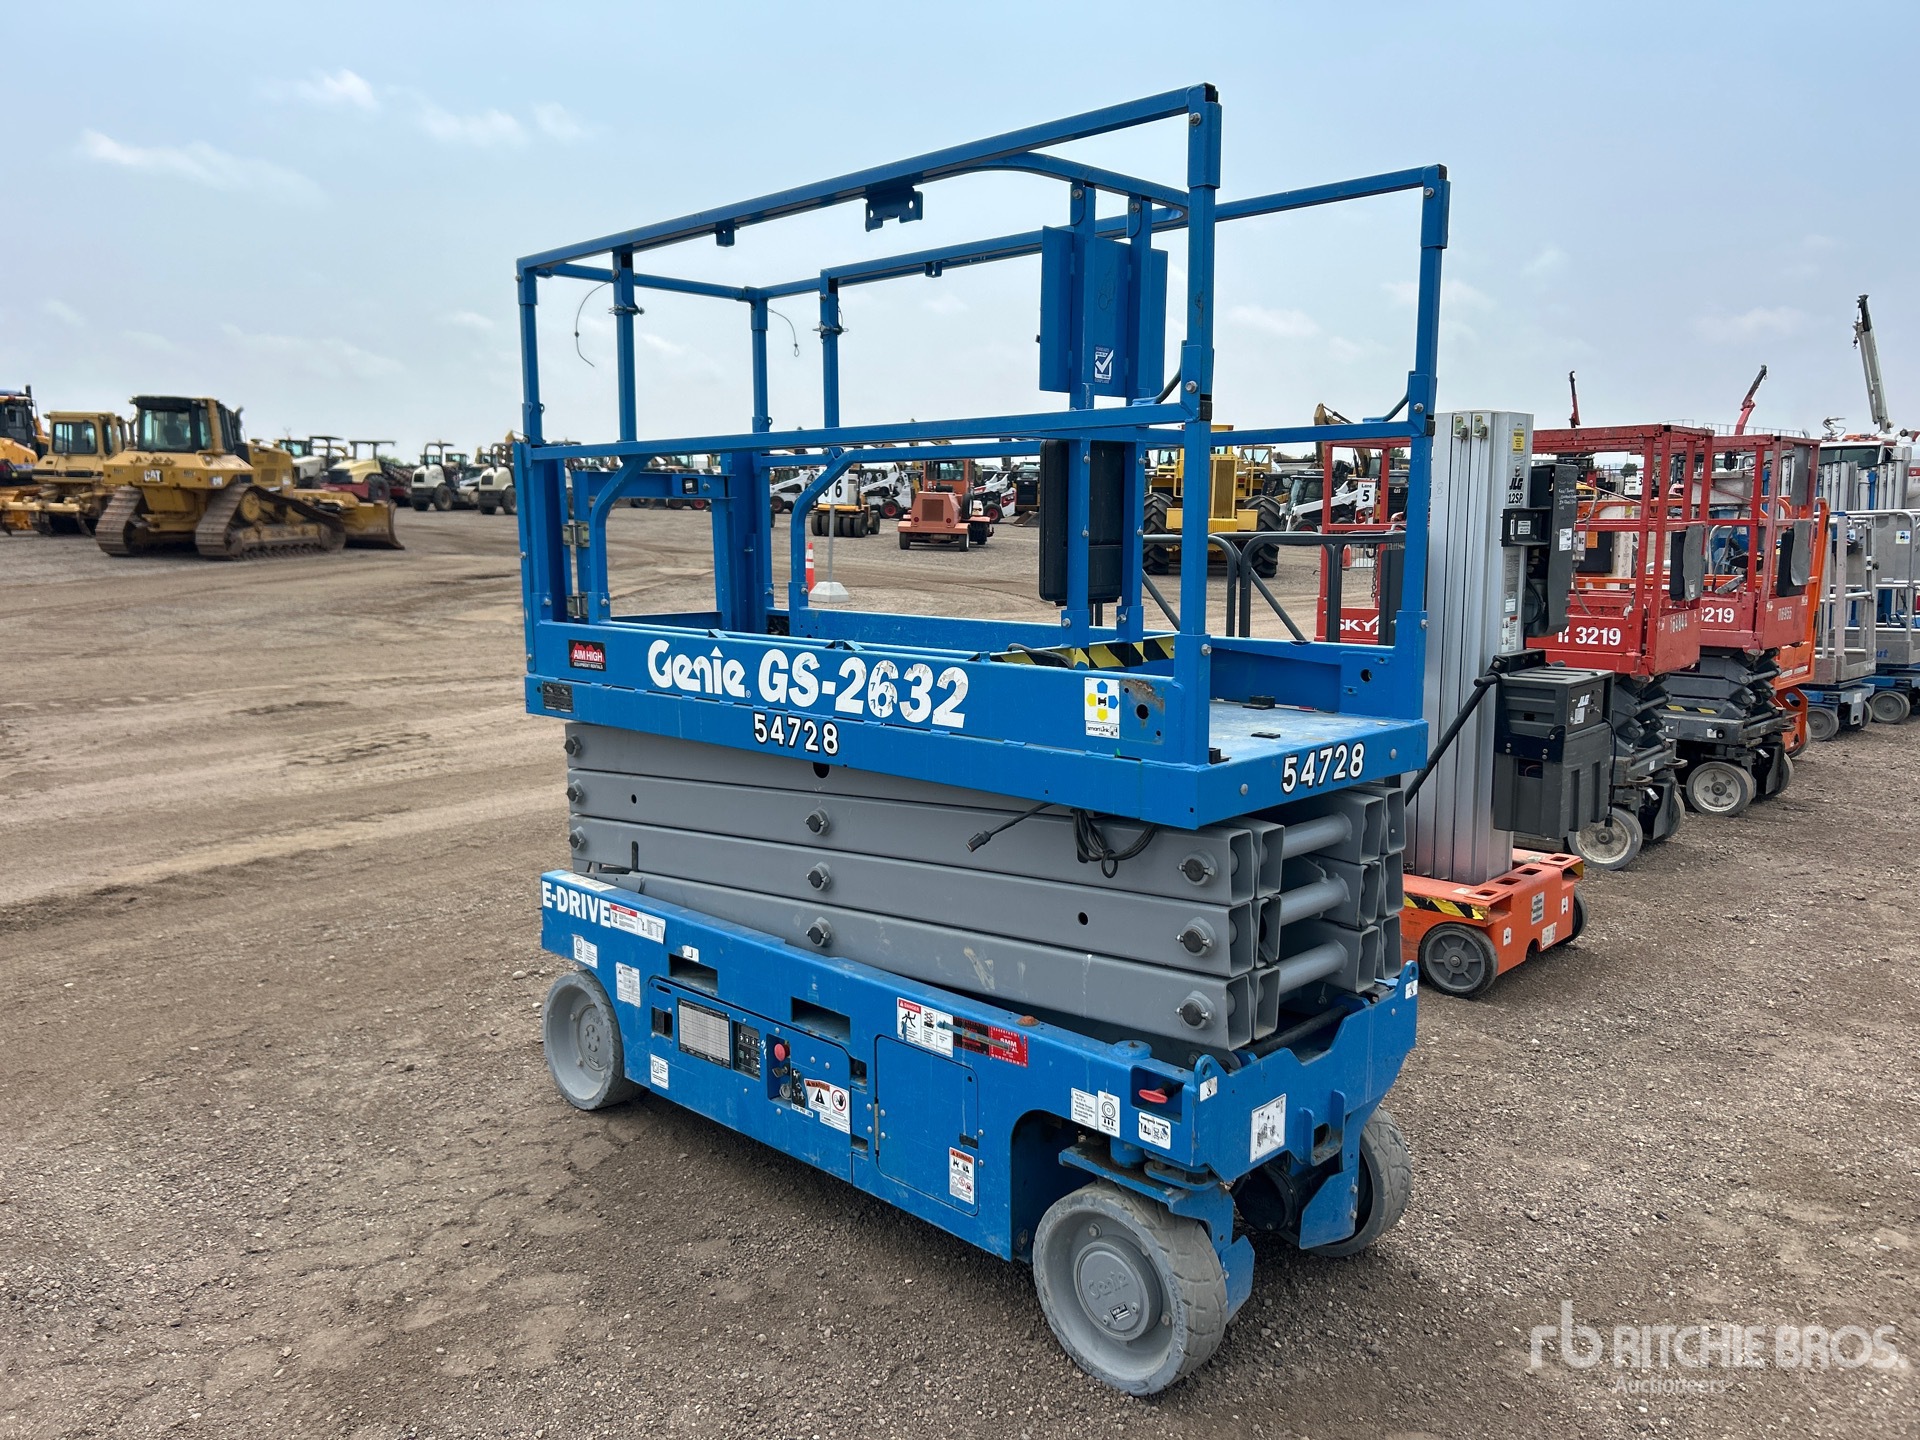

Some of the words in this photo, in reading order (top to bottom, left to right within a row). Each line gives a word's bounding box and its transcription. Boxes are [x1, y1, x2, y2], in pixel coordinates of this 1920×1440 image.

[143, 470, 161, 482] CAT
[1509, 478, 1524, 491] JLG
[1362, 490, 1370, 502] 5
[1508, 492, 1524, 504] 12SP
[1575, 626, 1621, 646] 3219
[573, 649, 586, 660] AIM
[586, 651, 603, 662] HIGH
[647, 639, 746, 698] Genie
[758, 648, 968, 729] GS-2632
[754, 713, 839, 755] 54728
[1282, 742, 1365, 793] 54728
[541, 881, 612, 928] E-DRIVE
